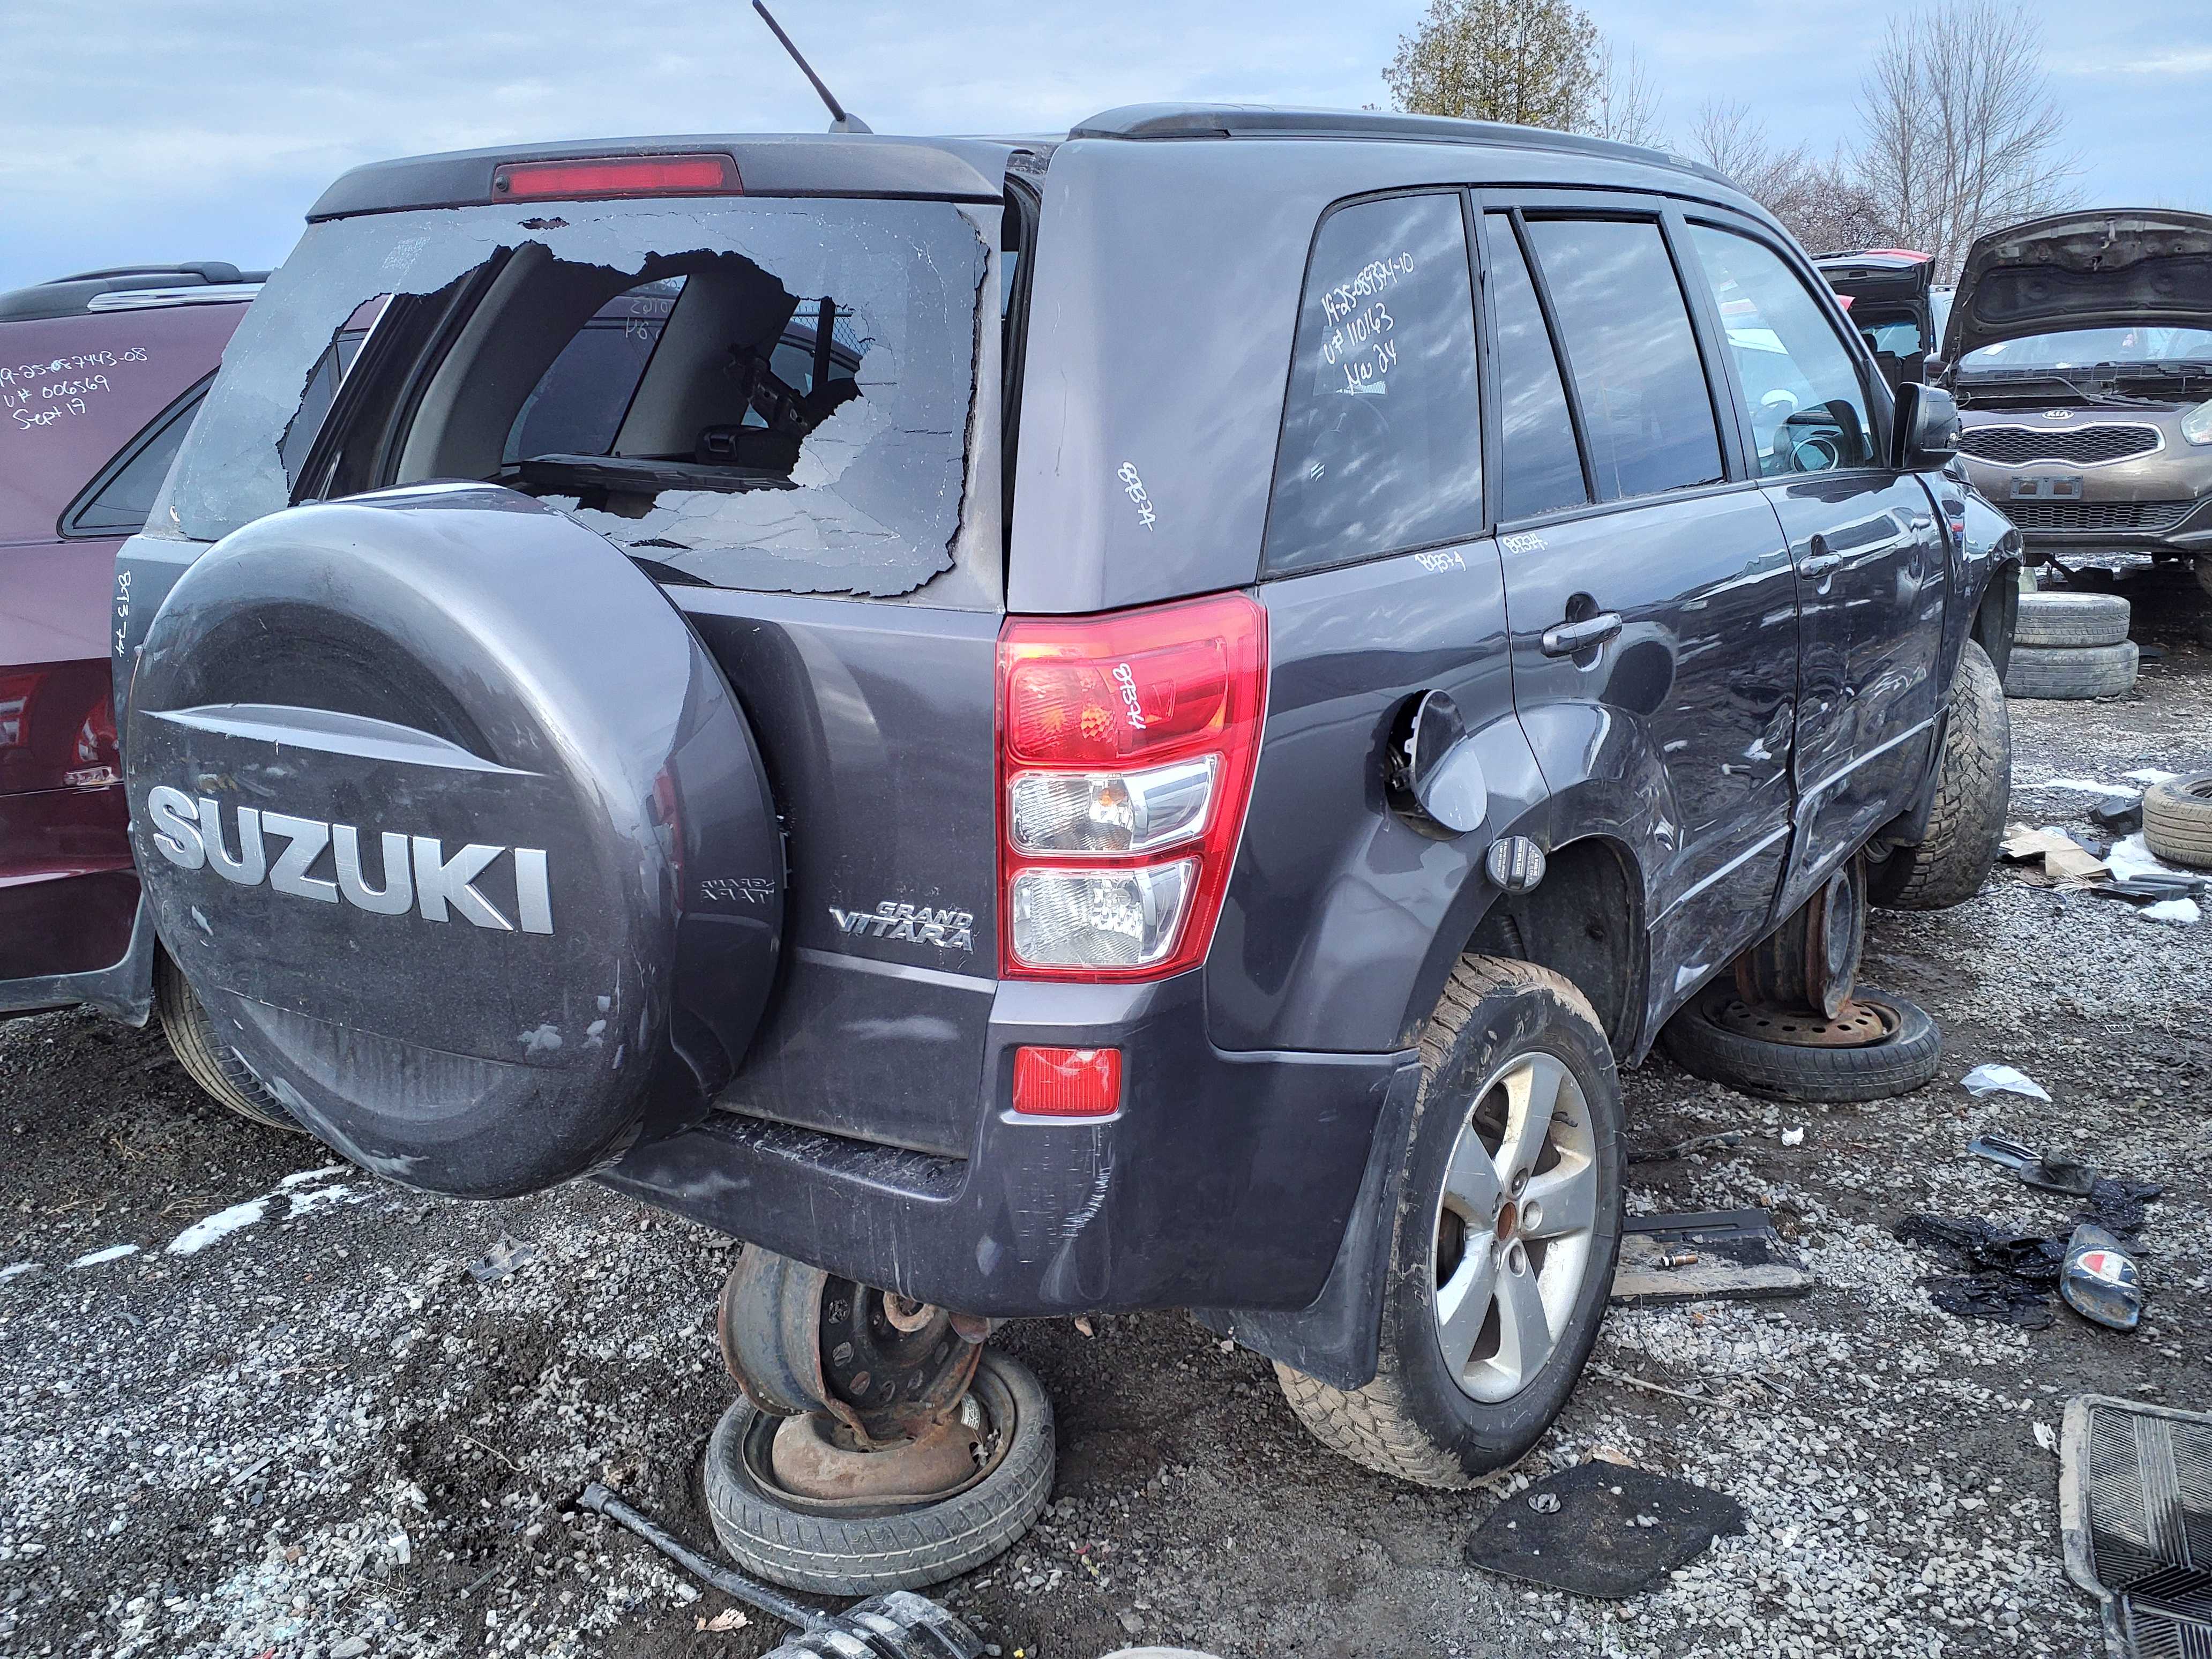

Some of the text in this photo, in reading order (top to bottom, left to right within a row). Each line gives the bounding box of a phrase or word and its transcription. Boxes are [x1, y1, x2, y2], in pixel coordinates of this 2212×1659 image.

[1346, 302, 1394, 347] 110163
[42, 374, 110, 399] 006569
[12, 405, 63, 430] Sept
[147, 785, 555, 935] SUZUKI
[828, 908, 974, 954] VITARA
[876, 901, 974, 930] GRAND
